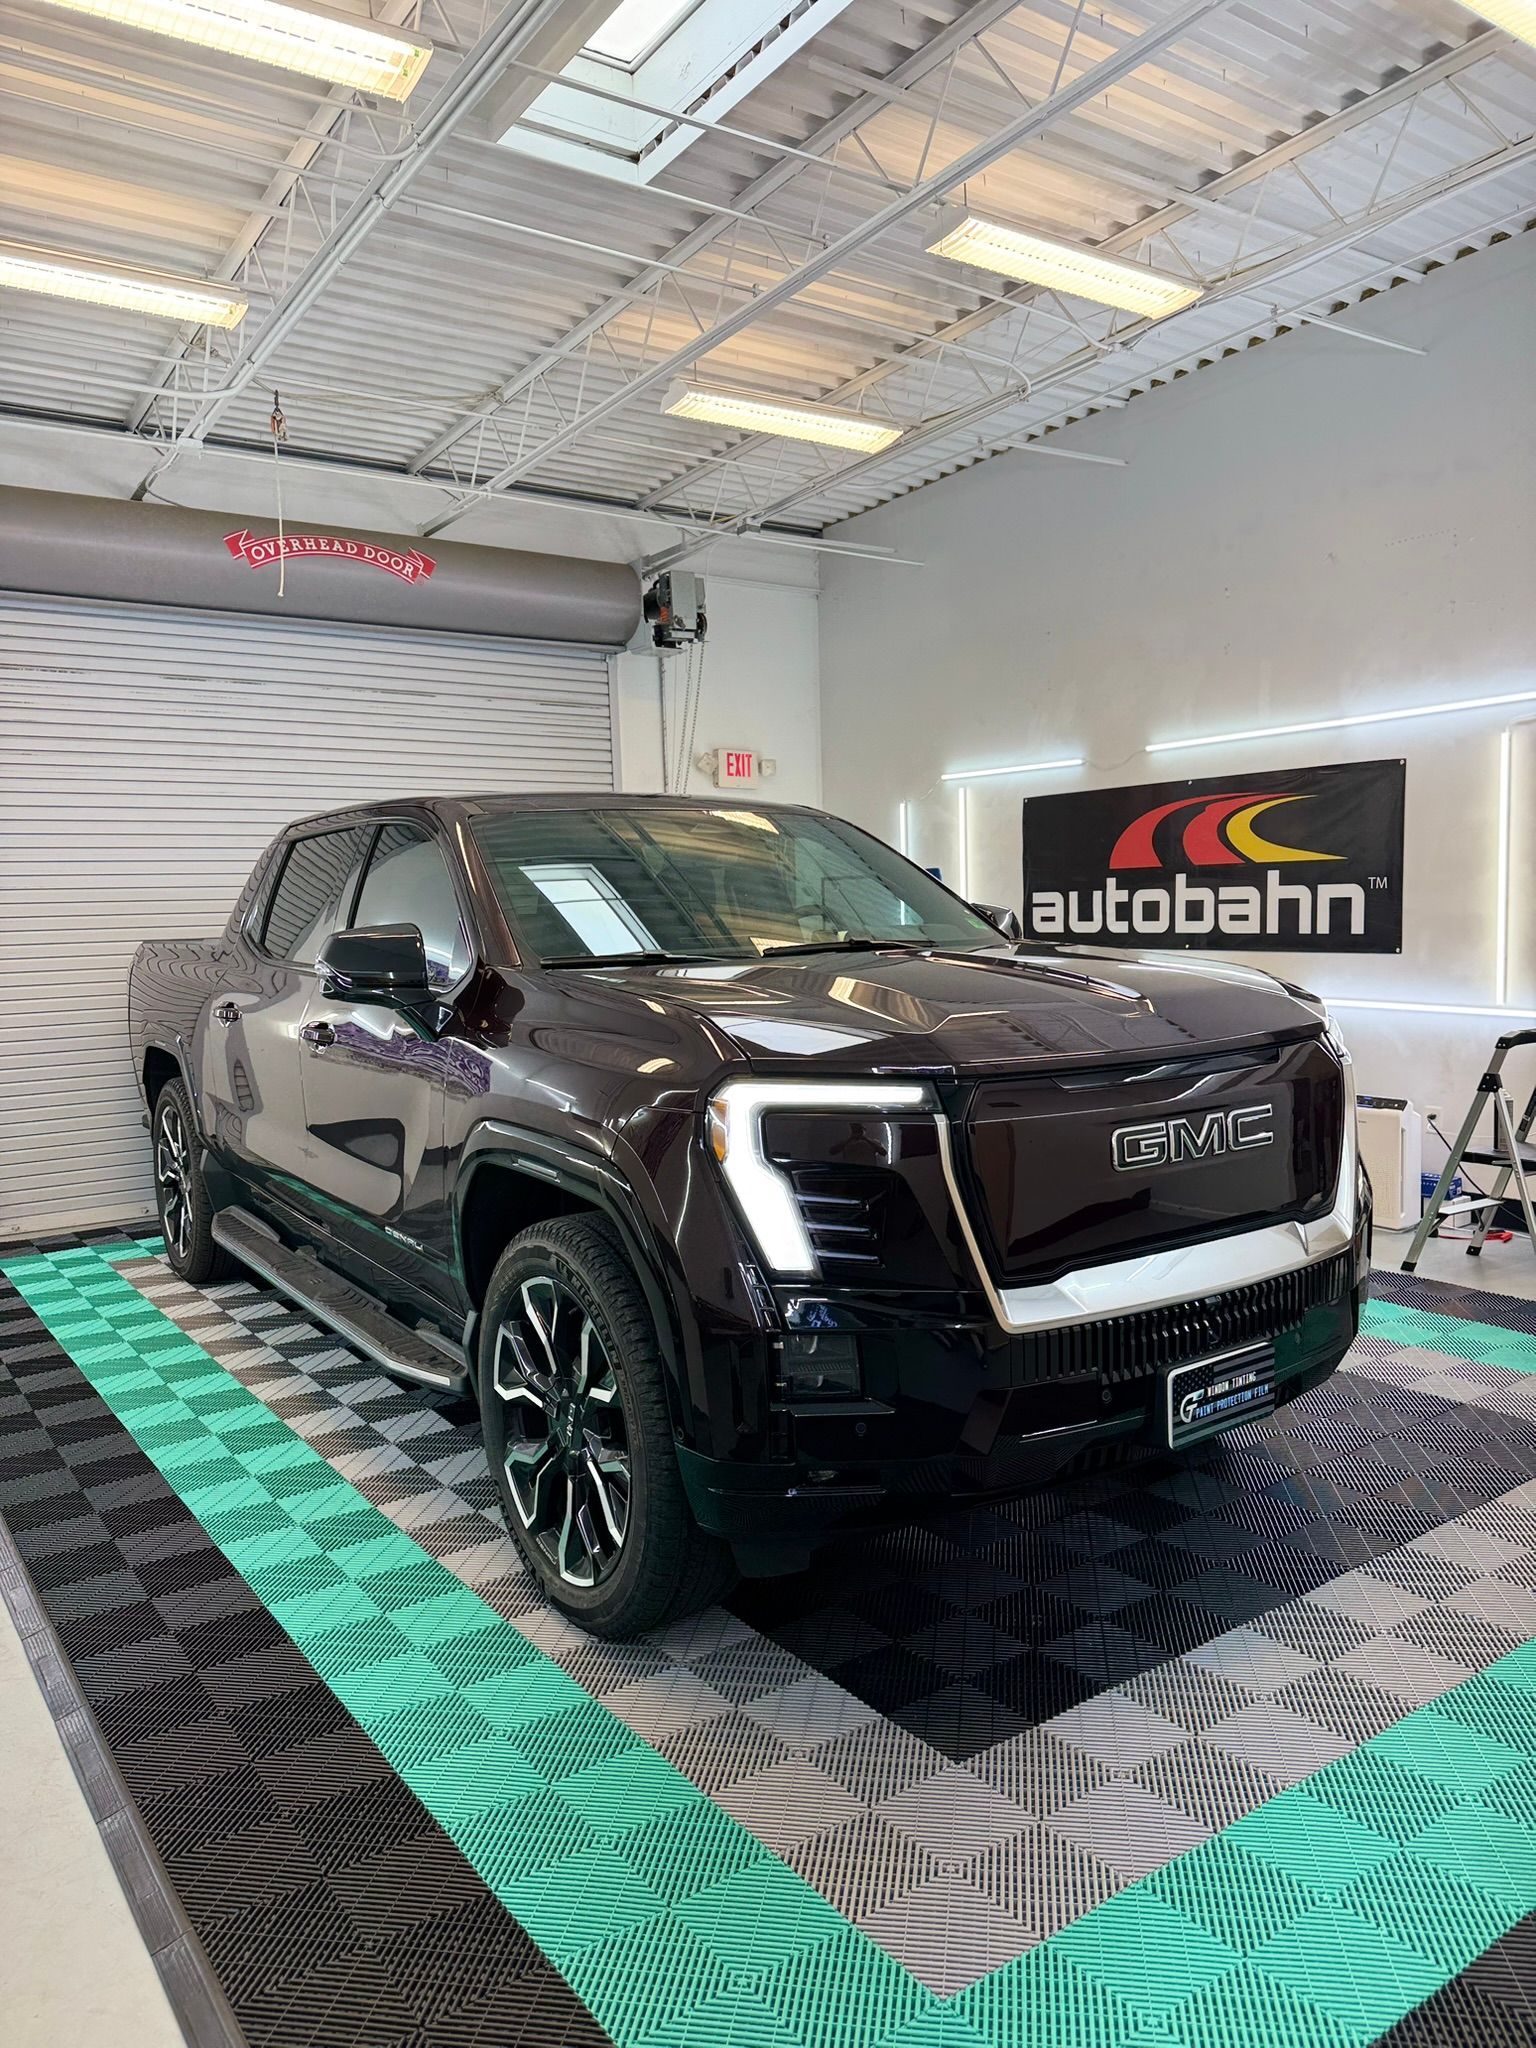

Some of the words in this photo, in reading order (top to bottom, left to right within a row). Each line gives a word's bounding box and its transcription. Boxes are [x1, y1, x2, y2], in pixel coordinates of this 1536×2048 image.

[251, 538, 358, 561] OVERHEAD
[363, 541, 414, 578] DOOR
[726, 753, 752, 777] EXIT
[1032, 869, 1365, 935] autobahn
[1111, 1103, 1274, 1172] GMC
[569, 1274, 621, 1365] MICHELIN
[1232, 1371, 1257, 1388] TINTING
[1195, 1402, 1214, 1419] PAINT
[1216, 1389, 1252, 1411] PROTECTION
[1254, 1384, 1269, 1398] FILM
